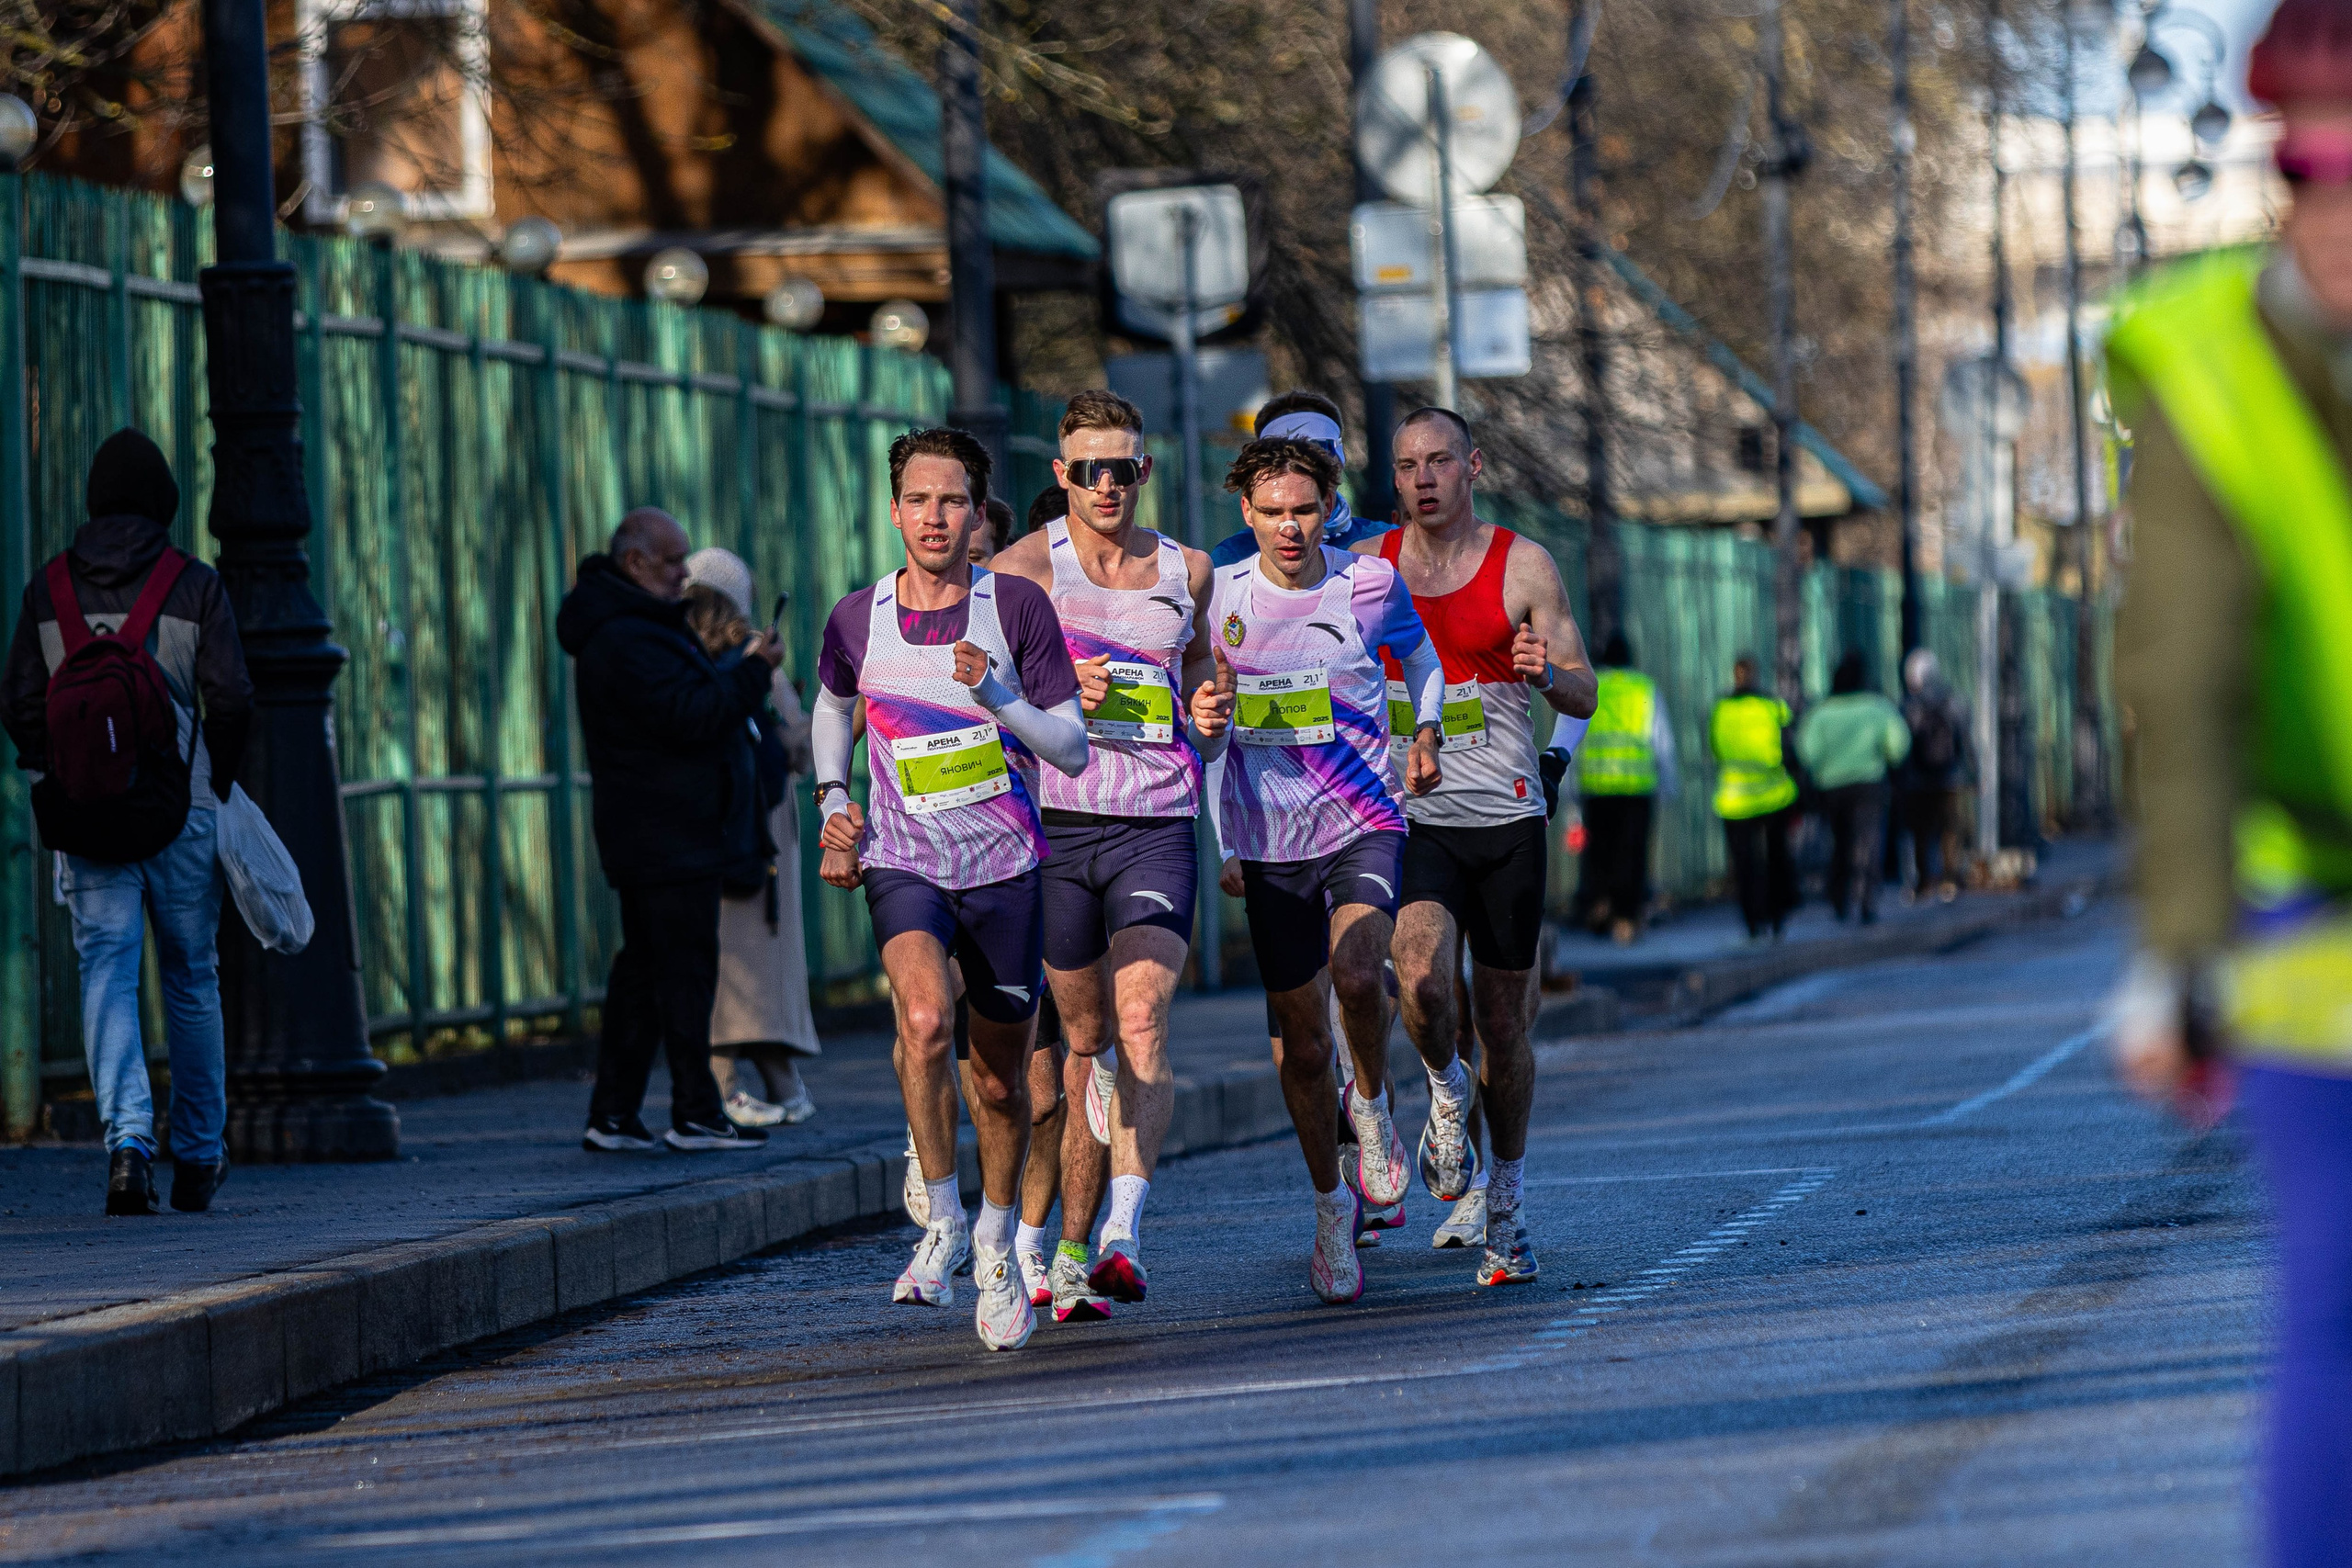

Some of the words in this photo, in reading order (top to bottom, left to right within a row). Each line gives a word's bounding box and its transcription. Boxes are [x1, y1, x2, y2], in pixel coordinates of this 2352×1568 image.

[1112, 668, 1144, 677] АРЕНА
[1153, 671, 1165, 681] 21,1
[1260, 678, 1293, 688] АРЕНА
[1303, 674, 1319, 684] 21,1
[1456, 686, 1472, 696] 21,1
[1120, 697, 1152, 707] БЯКИН
[1272, 704, 1307, 715] ПОПОВ
[972, 728, 989, 740] 21,1
[927, 736, 961, 748] АРЕНА
[927, 742, 963, 751] ПОЛУМАРАФОН
[940, 759, 983, 776] ЯНОВИЧ
[987, 766, 1003, 776] 2025
